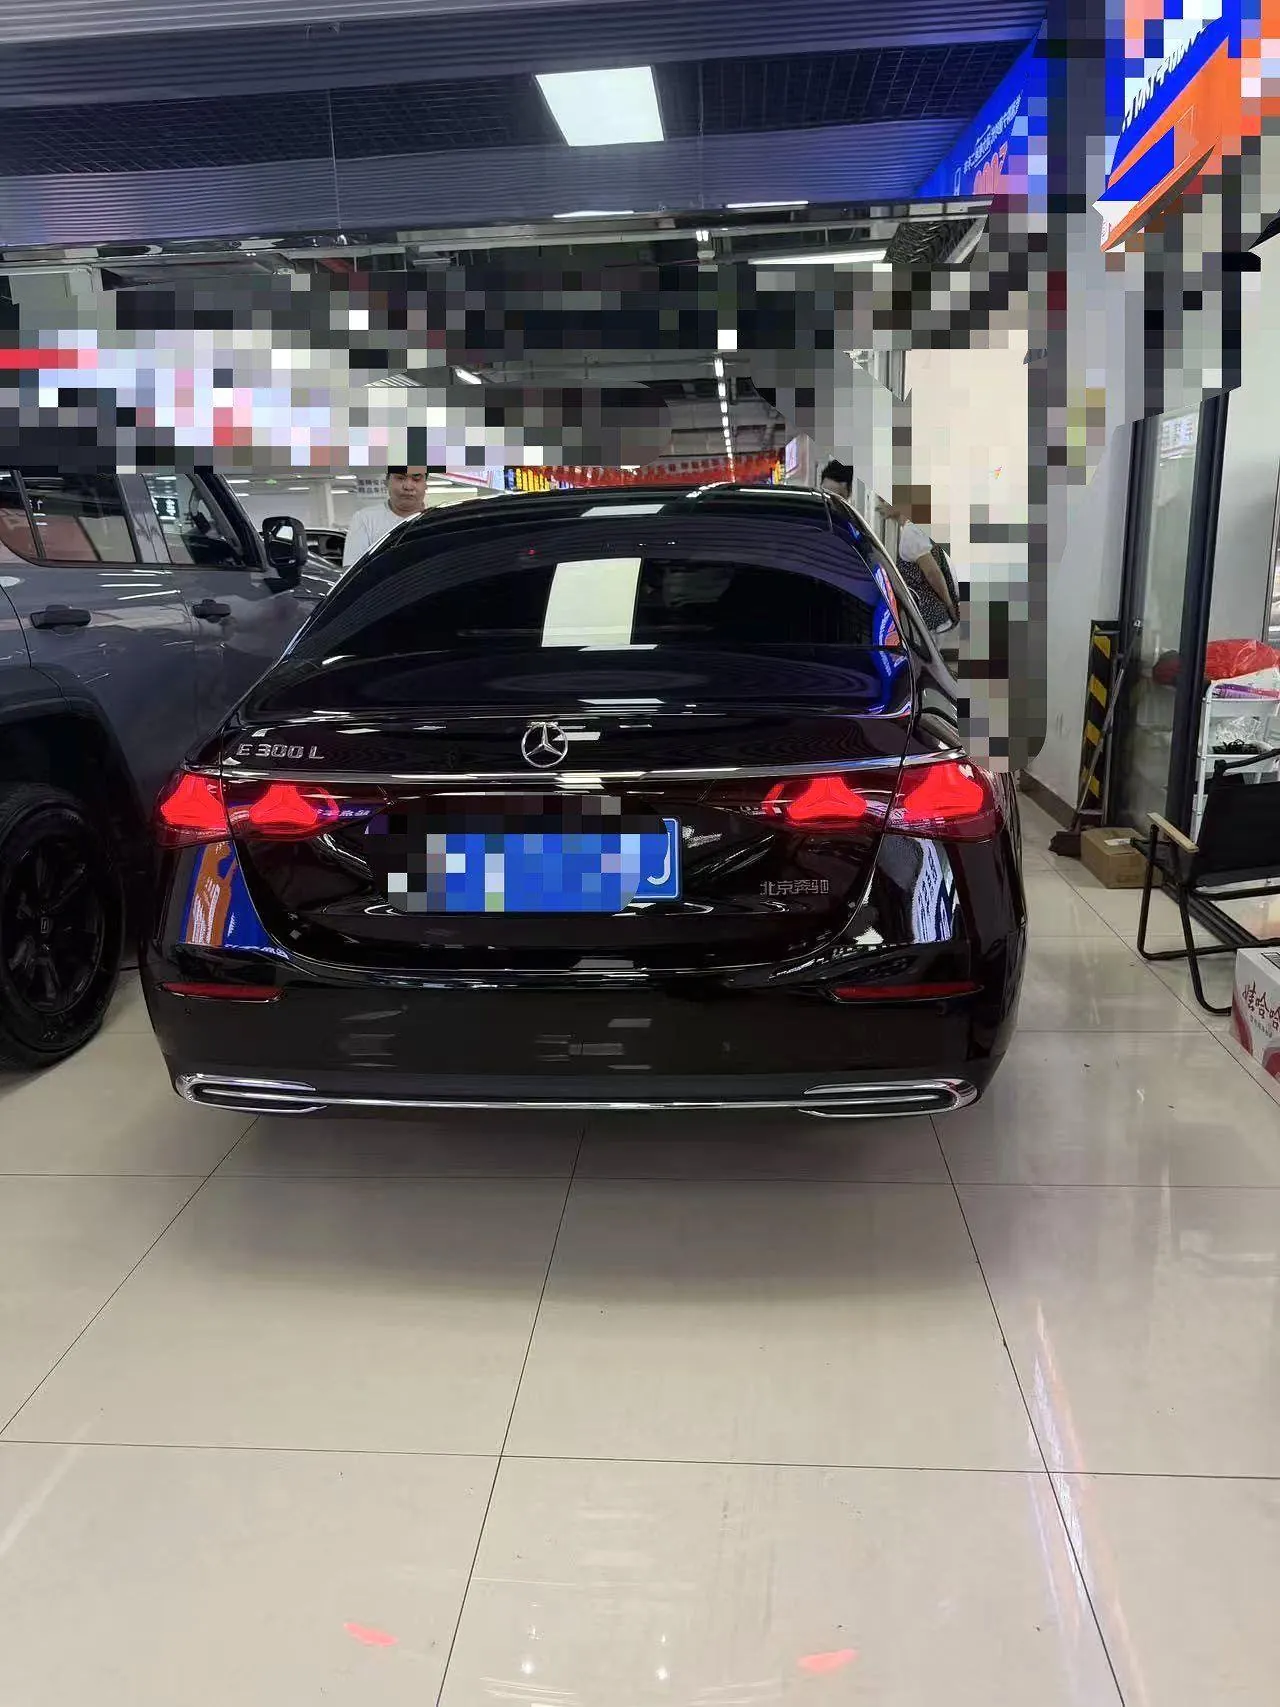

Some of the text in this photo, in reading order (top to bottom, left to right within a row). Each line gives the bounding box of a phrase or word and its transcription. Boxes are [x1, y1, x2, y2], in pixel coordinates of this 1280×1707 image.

[236, 743, 325, 759] E 300 L
[759, 879, 829, 896] 北京奔驰
